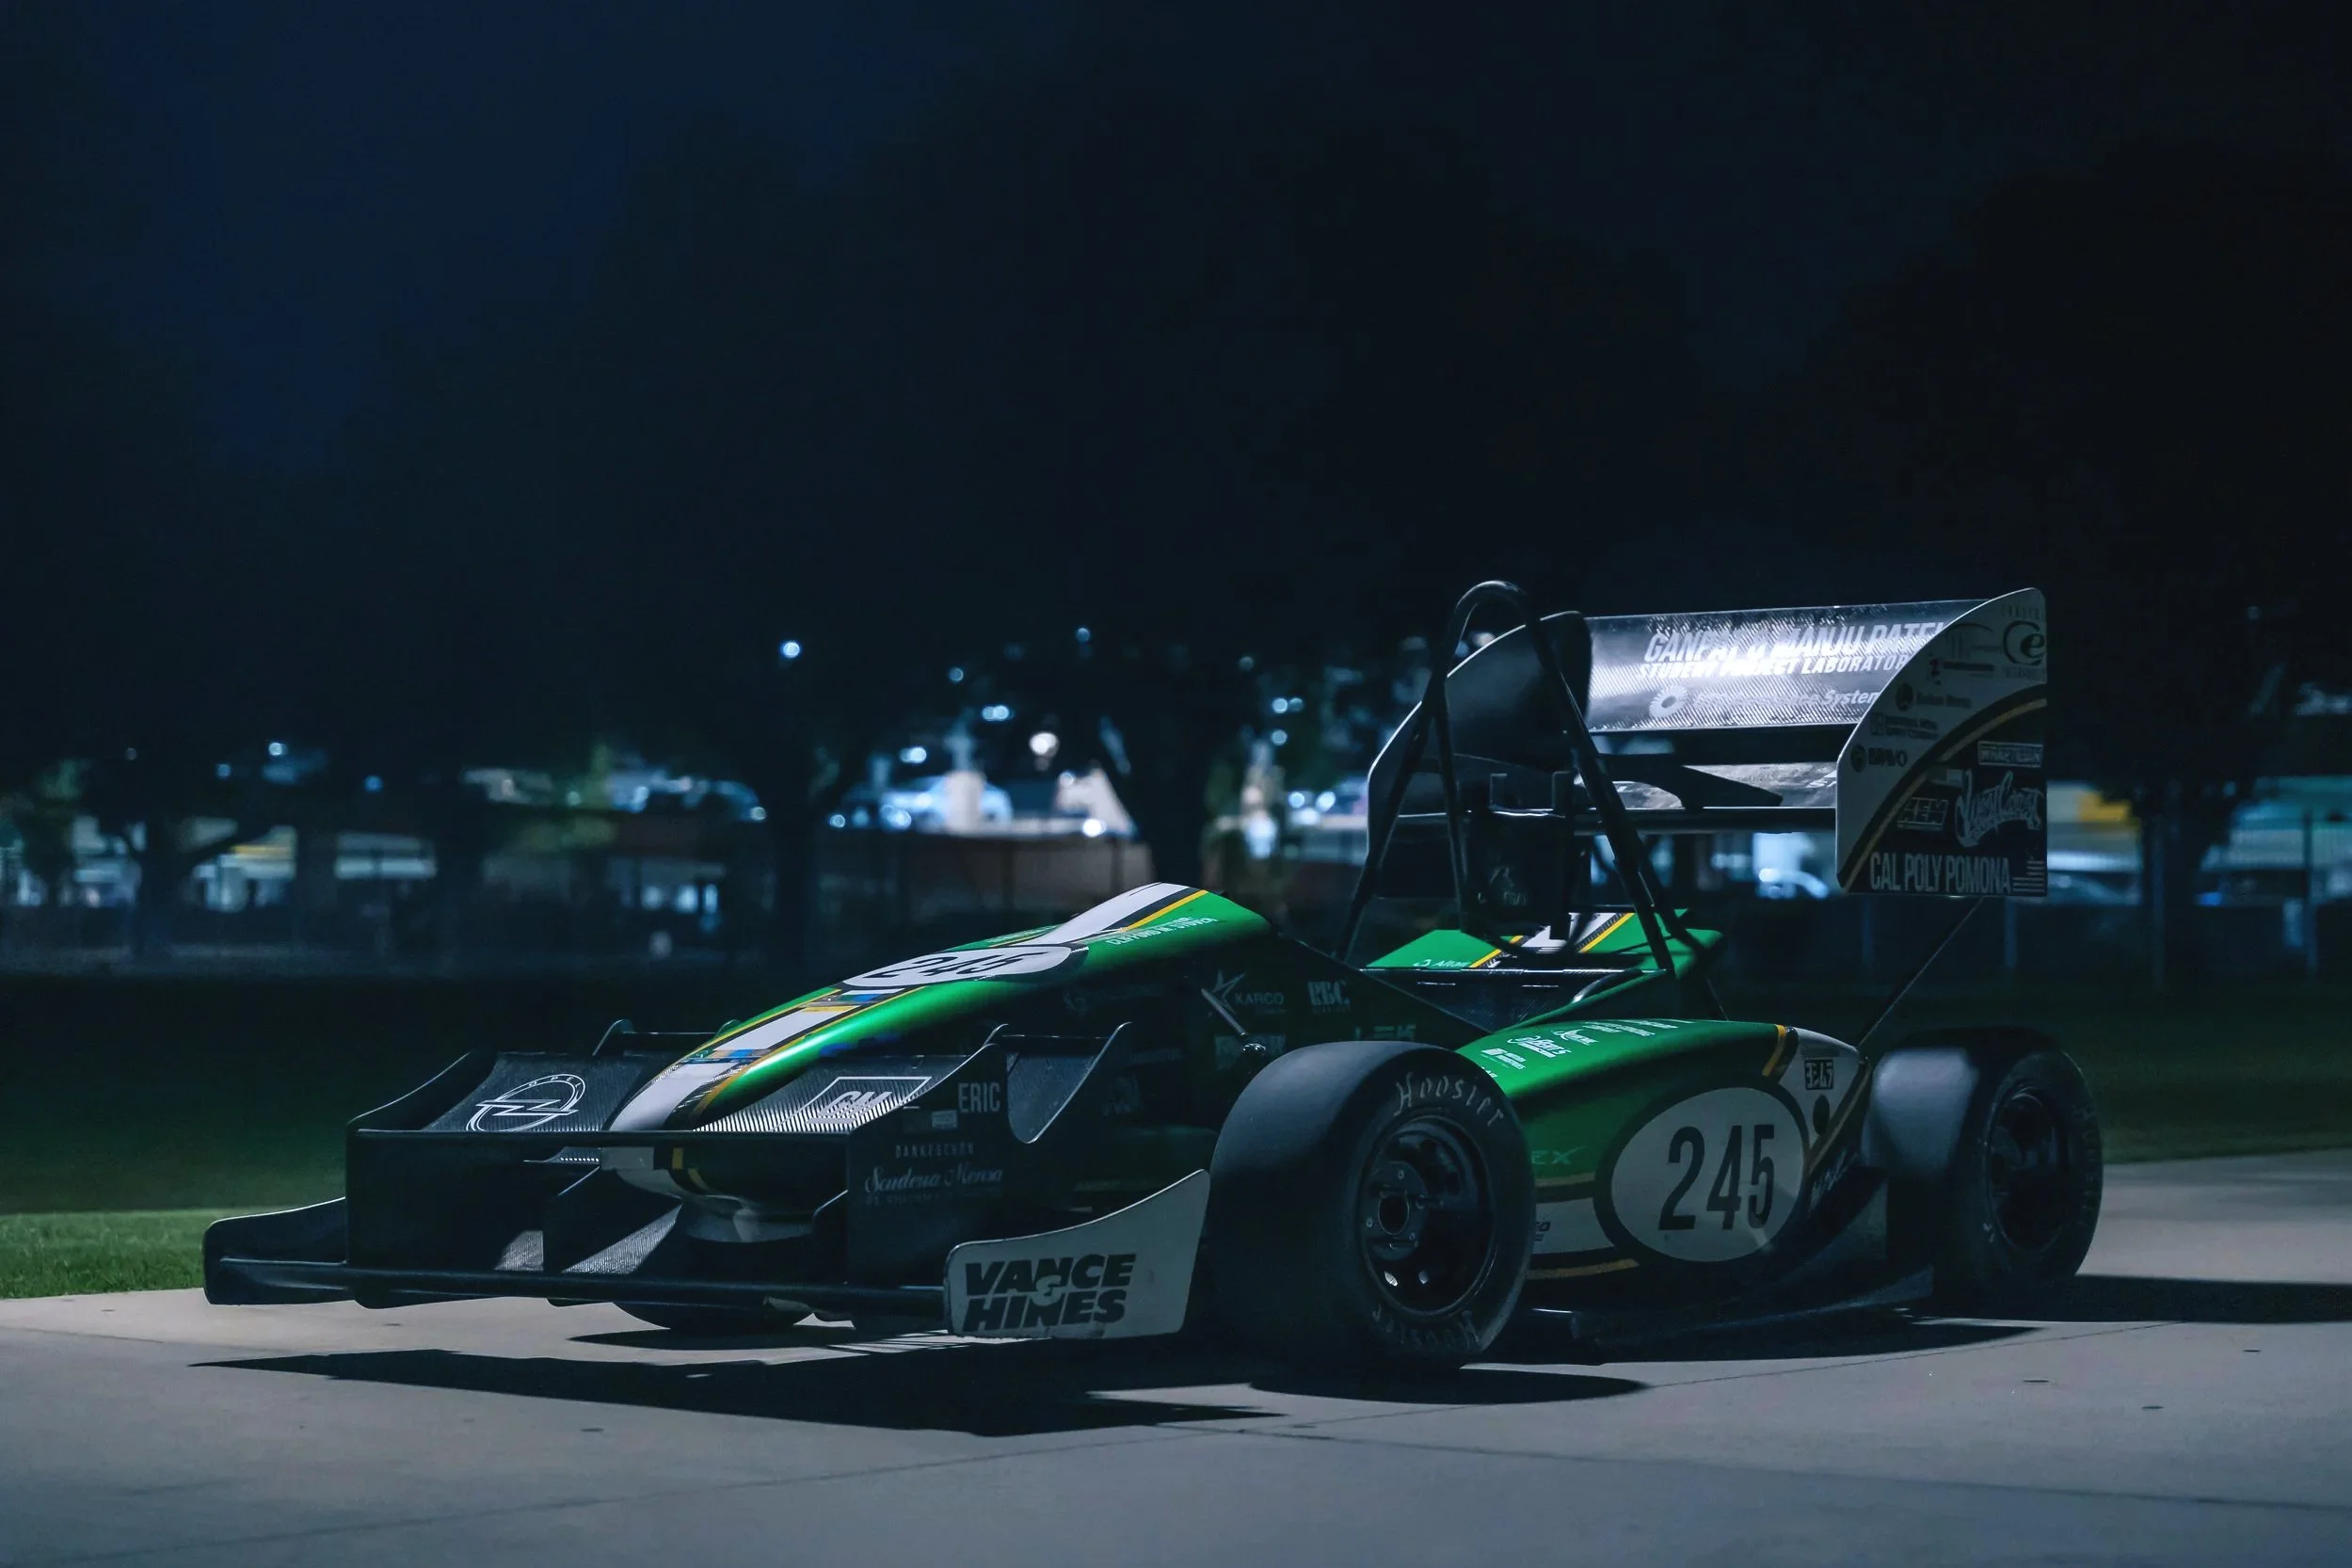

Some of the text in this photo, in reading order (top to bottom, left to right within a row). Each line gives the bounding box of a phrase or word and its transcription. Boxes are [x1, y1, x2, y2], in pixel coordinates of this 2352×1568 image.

[1801, 654, 1910, 675] LABORATOR
[1869, 852, 2012, 894] CAL POLY POMONA
[1234, 991, 1285, 1005] KARCO
[957, 1081, 1000, 1113] ERIC
[1657, 1124, 1775, 1231] 245
[965, 1254, 1136, 1296] VANCE
[962, 1289, 1128, 1333] HINES
